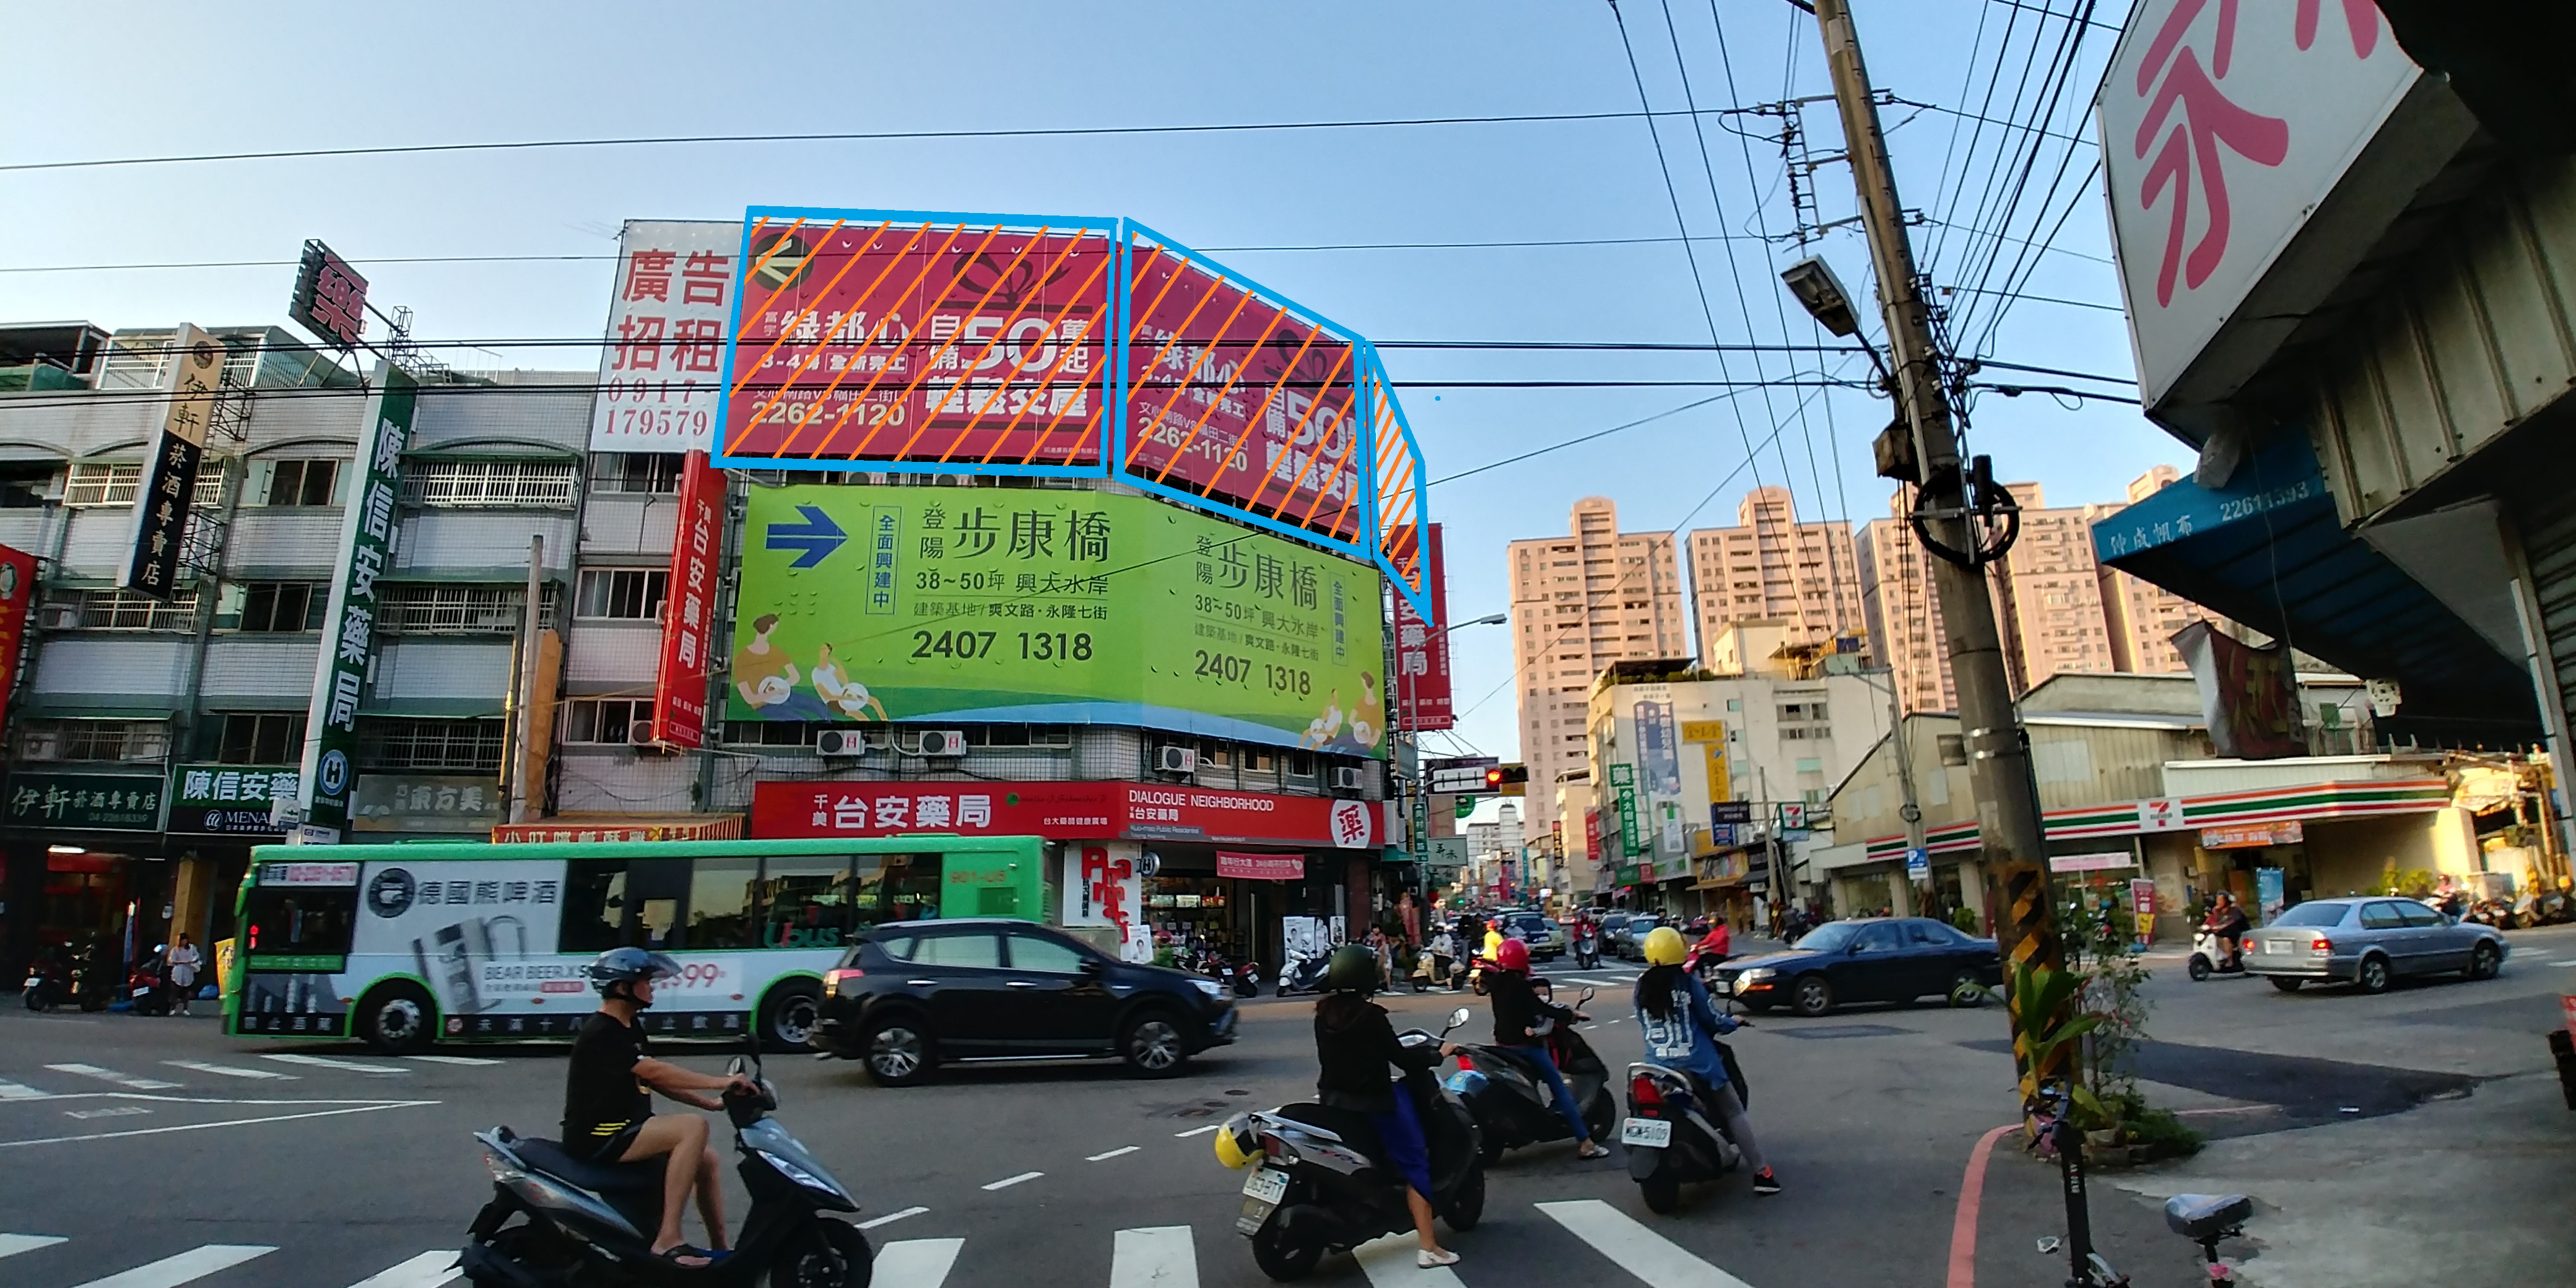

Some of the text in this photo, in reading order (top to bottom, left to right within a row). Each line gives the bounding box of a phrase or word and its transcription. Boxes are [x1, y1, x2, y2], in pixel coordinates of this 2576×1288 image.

[622, 248, 730, 307] 廣告
[612, 315, 722, 372] 招租
[780, 308, 910, 349] 綠都心
[929, 315, 1090, 373] 自備 50 萬起
[173, 372, 209, 438] 伊軒
[604, 409, 708, 436] 179579
[749, 401, 906, 427] 2262-1120
[1287, 390, 1347, 459] 50
[1137, 416, 1248, 472] 2262-1120
[141, 443, 187, 586] 菸酒專賣店
[919, 507, 1110, 562] 登陽 步康橋
[328, 417, 406, 733] 陳信安藥局
[873, 514, 896, 609] 全面興建中
[1016, 573, 1109, 595] 興大水岸
[1196, 534, 1318, 611] 登陽 步康橋
[911, 630, 1092, 661] 2407 1318
[1194, 649, 1311, 695] 2407 1318
[812, 794, 991, 829] 千美 台安藥局
[1129, 790, 1274, 811] DIALOGUE NEIGHBORHOOD
[418, 880, 559, 905] 德國熊啤酒
